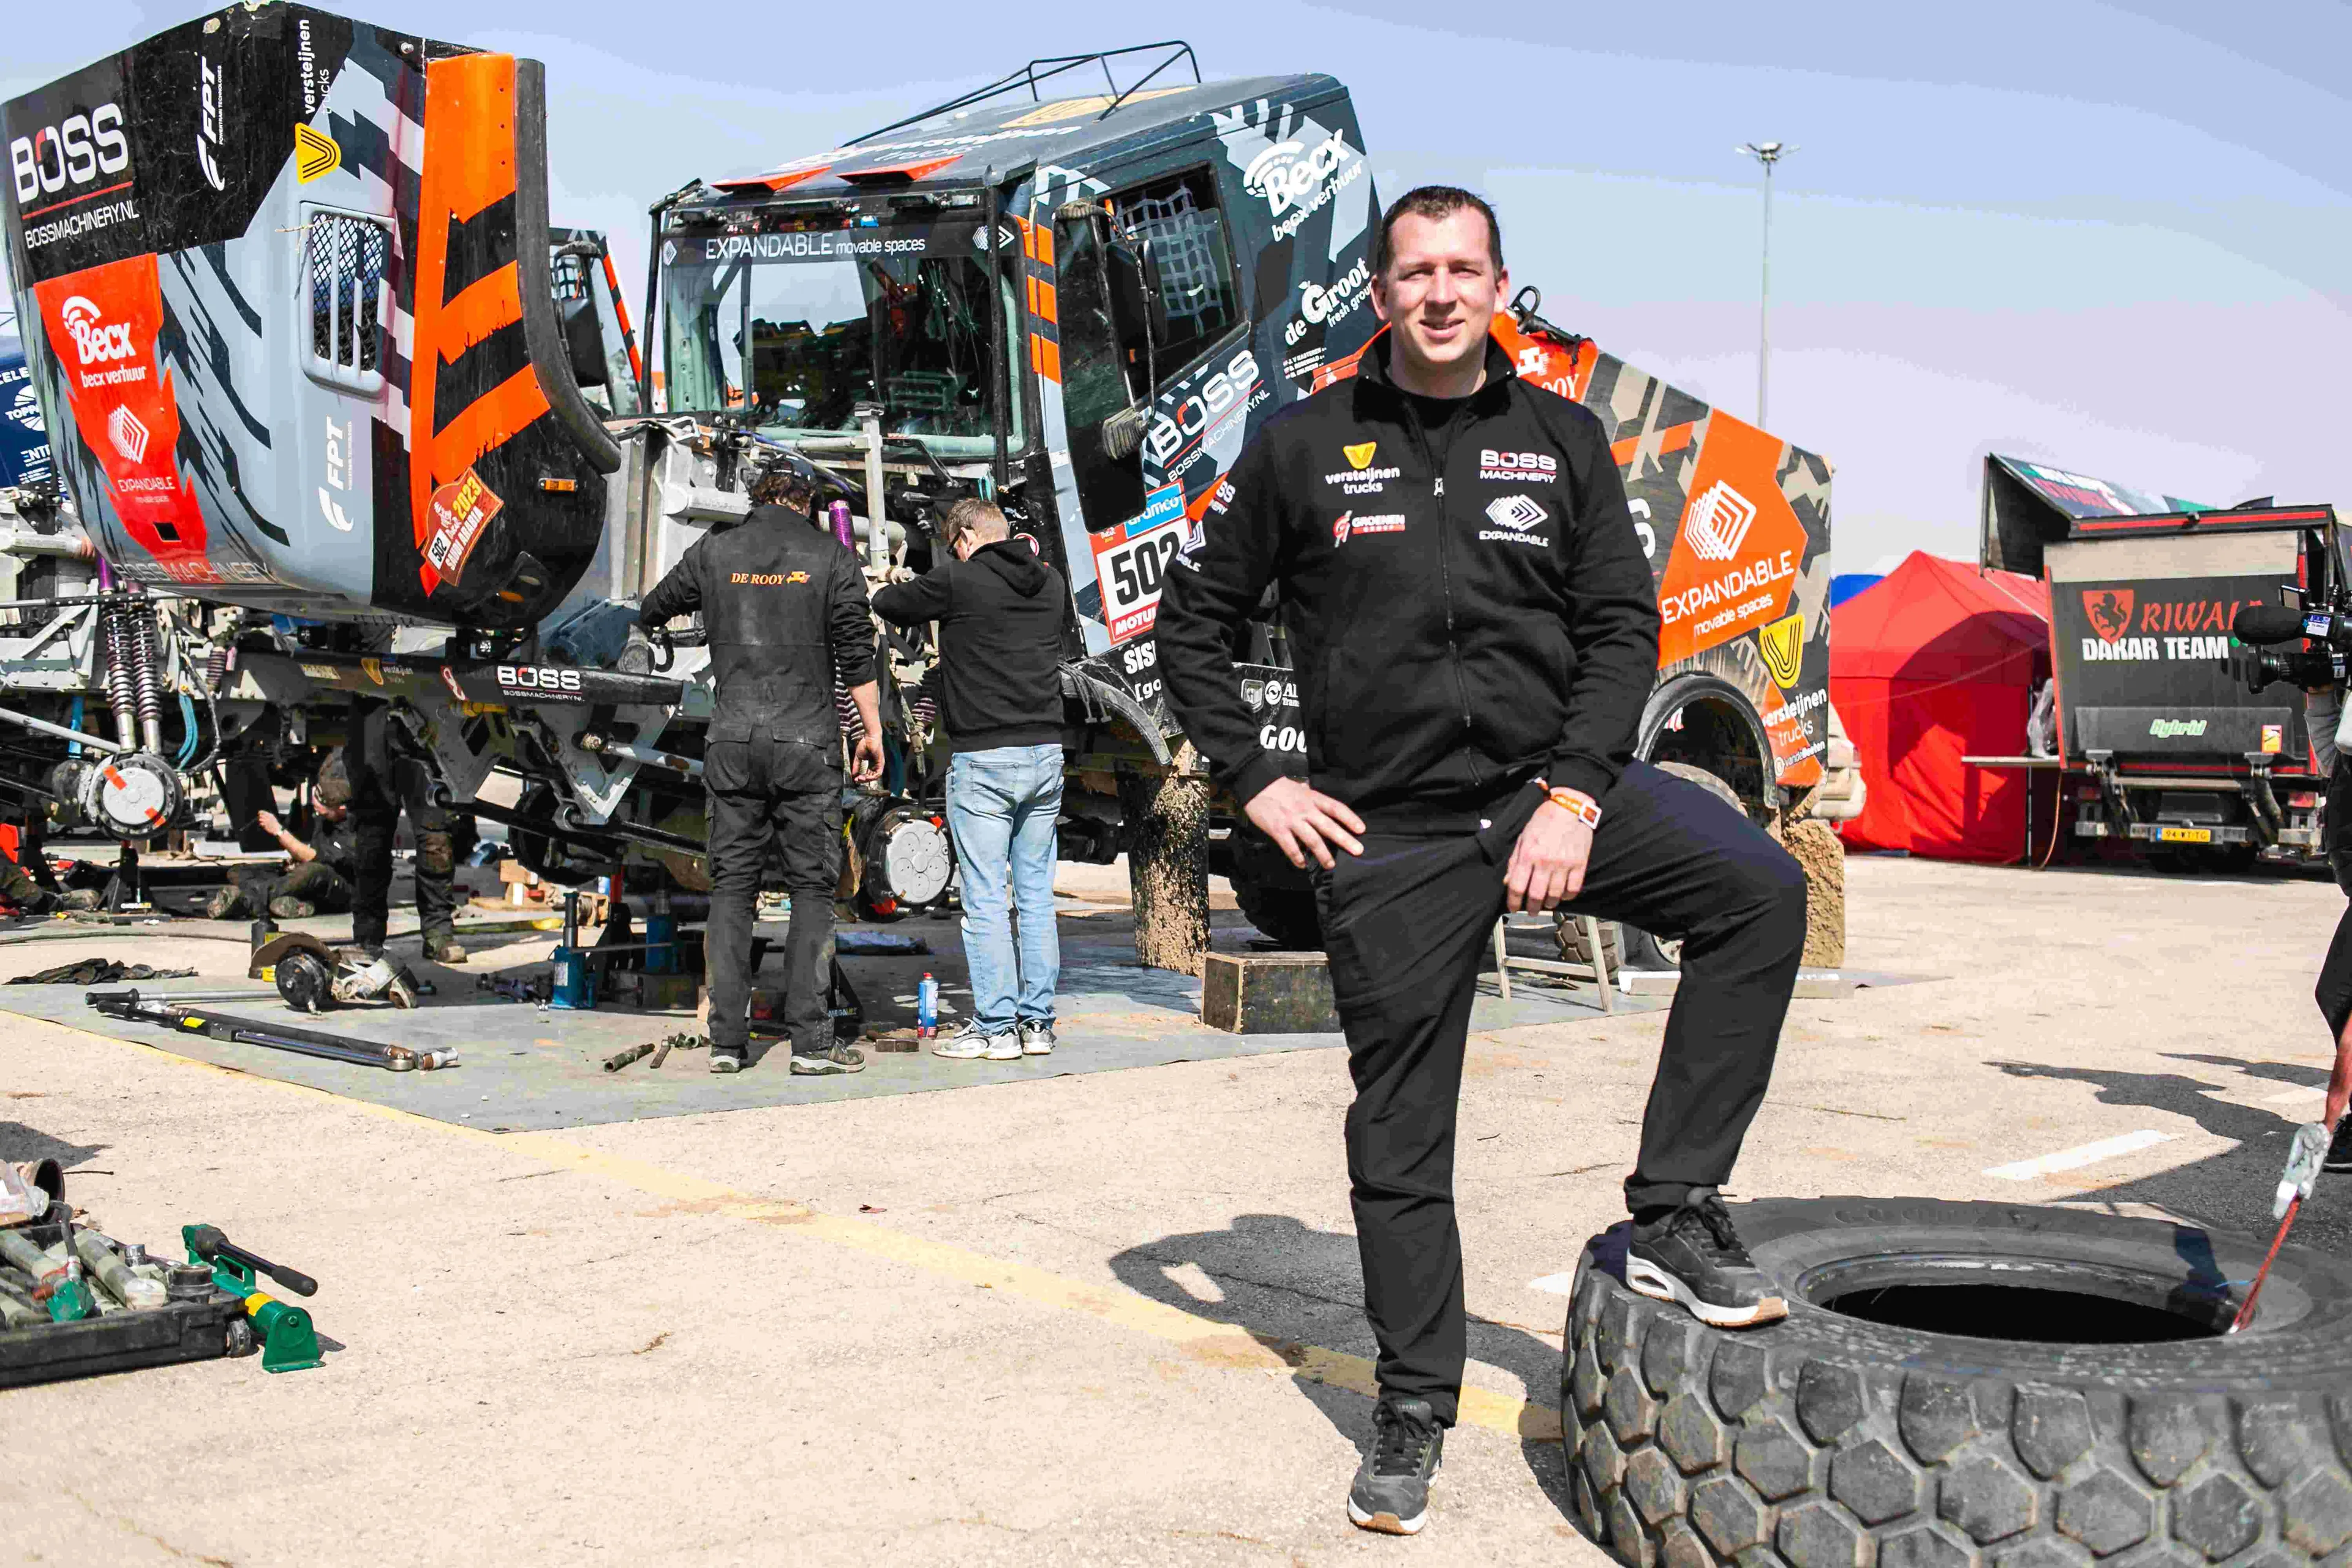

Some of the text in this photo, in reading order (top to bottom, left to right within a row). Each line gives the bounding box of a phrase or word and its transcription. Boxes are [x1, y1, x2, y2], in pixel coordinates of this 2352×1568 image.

[299, 20, 316, 115] versteijnen
[202, 56, 217, 144] FPT
[318, 69, 331, 115] trucks
[10, 103, 128, 203] BOSS
[1263, 128, 1350, 217] Becx
[1272, 160, 1362, 242] becx verhuur
[24, 200, 140, 249] BOSSMACHINERY.NL
[706, 233, 925, 260] EXPANDABLE movable spaces
[1285, 320, 1307, 345] de
[1302, 258, 1370, 324] Groot
[1327, 303, 1351, 328] fresh
[74, 319, 135, 364] Becx
[81, 364, 147, 388] becx verhuur
[1150, 350, 1259, 462] BOSS
[326, 415, 343, 490] FPT
[1167, 390, 1271, 483] BOSSMACHINERY.NL
[1325, 467, 1400, 484] versteijnen
[1480, 469, 1556, 484] MACHINERY
[1481, 450, 1557, 471] BOSS
[118, 477, 176, 492] EXPANDABLE
[453, 477, 482, 521] 2023
[1343, 482, 1383, 494] trucks
[432, 537, 447, 562] 502
[445, 505, 484, 571] SAUDI ARABIA
[1479, 530, 1549, 547] EXPANDABLE
[731, 573, 785, 584] DE ROOY
[1111, 532, 1180, 606] 502
[1661, 549, 1795, 625] EXPANDABLE
[1694, 592, 1774, 638] movable spaces
[2082, 636, 2229, 661] DAKAR TEAM
[497, 665, 581, 690] BOSS
[1779, 719, 1814, 747] trucks
[2149, 719, 2207, 739] Hybrid
